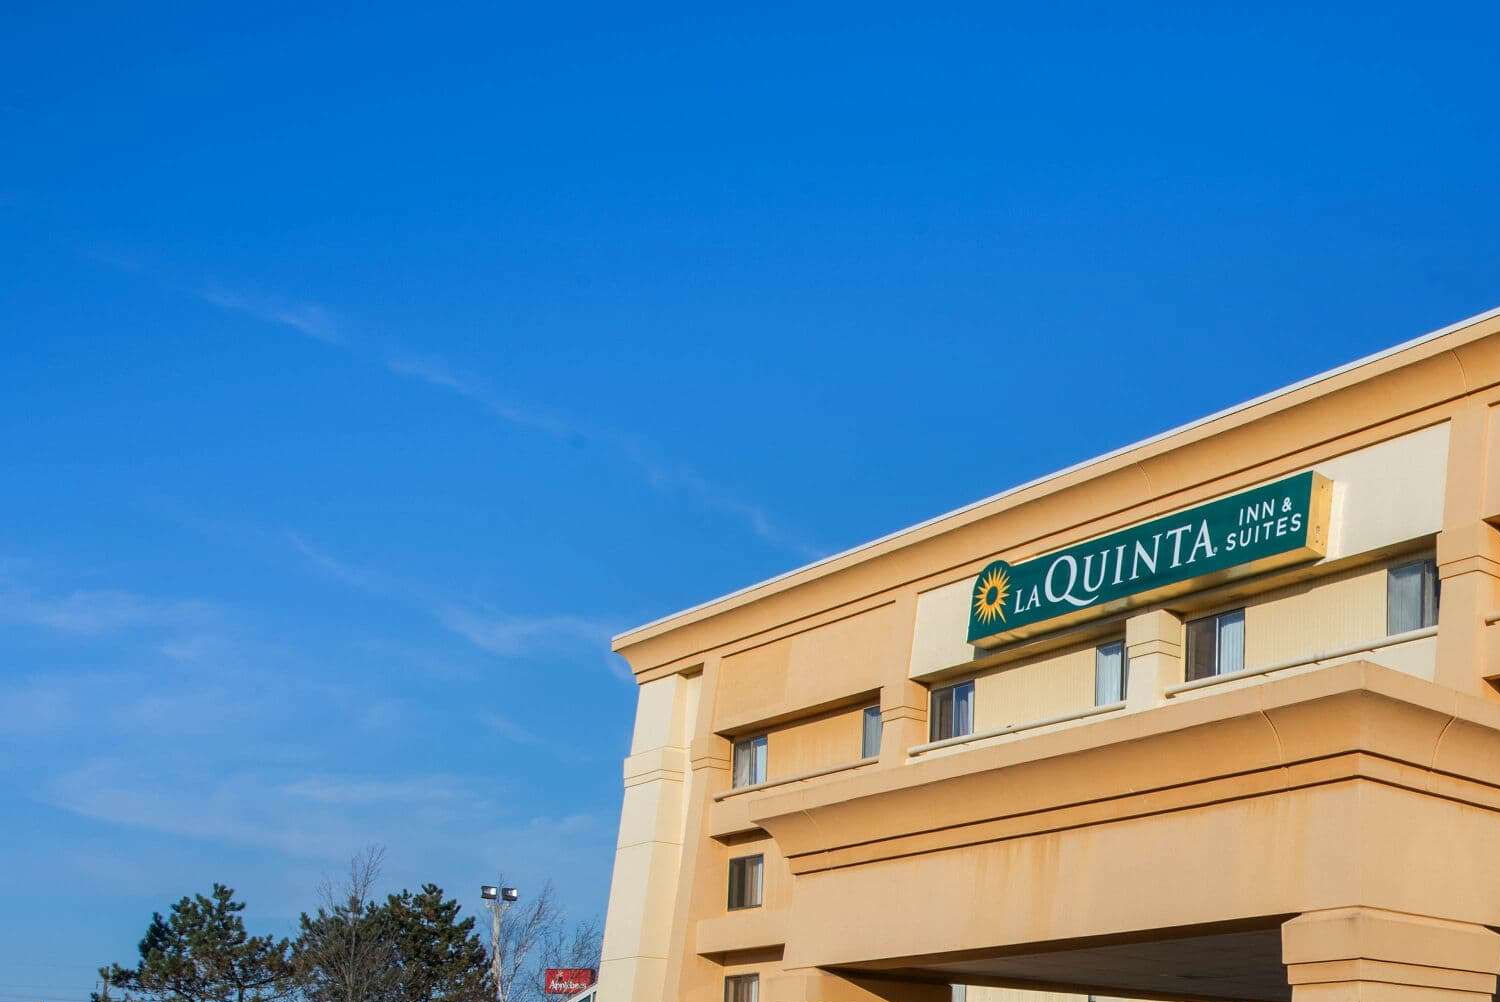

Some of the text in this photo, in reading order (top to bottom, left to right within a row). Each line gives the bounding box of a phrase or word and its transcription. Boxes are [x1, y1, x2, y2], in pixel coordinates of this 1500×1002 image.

[1239, 496, 1292, 526] INN &
[1225, 513, 1301, 551] SUITES
[1013, 518, 1216, 614] LA QUINTA
